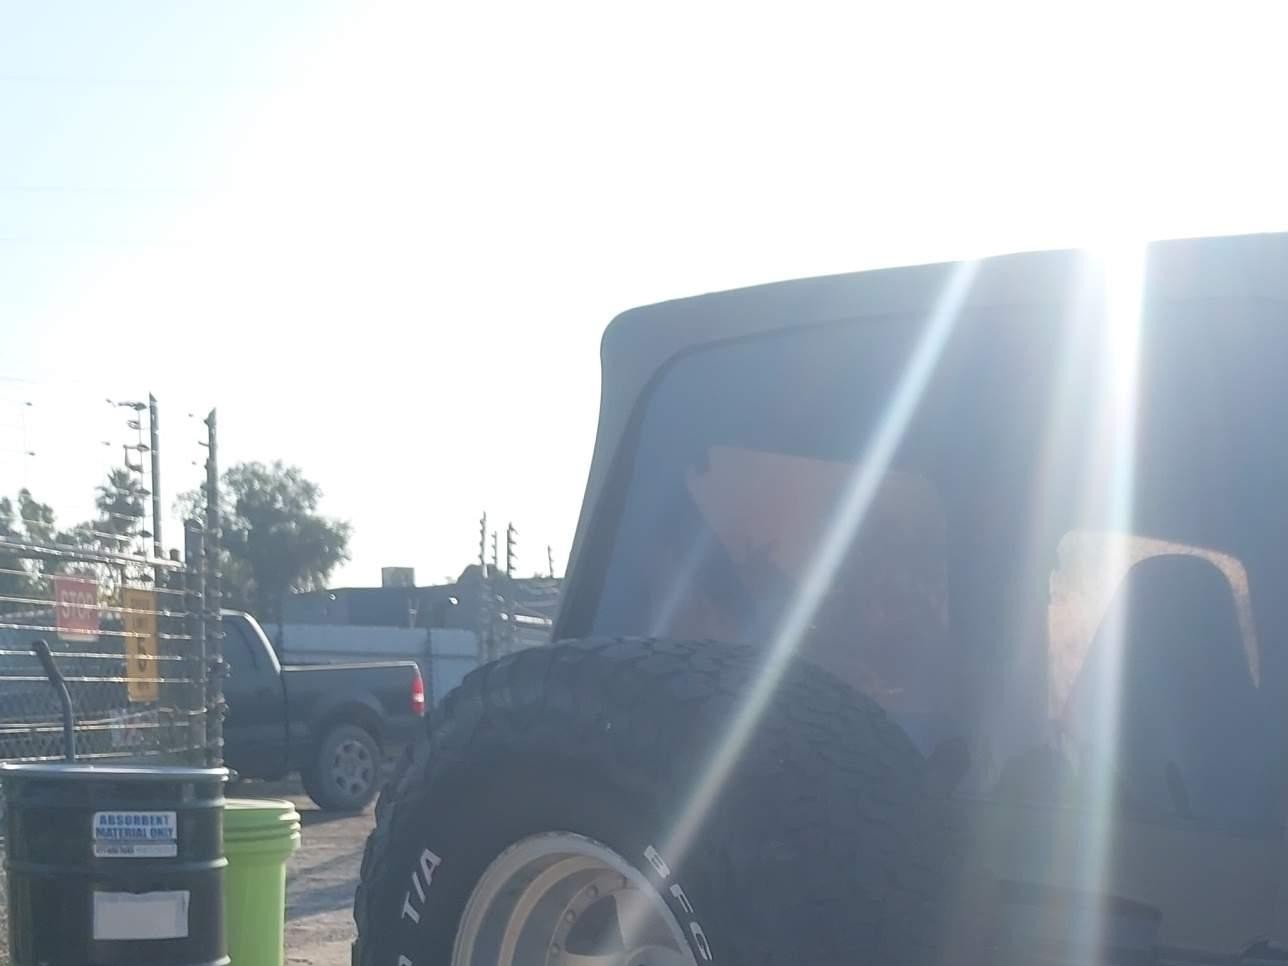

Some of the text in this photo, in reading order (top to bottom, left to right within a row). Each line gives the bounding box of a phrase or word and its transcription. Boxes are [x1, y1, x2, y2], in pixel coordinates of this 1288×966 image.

[61, 590, 95, 619] STOP
[100, 815, 169, 826] ABSORBENT
[96, 828, 174, 839] MATERIAL ONLY
[401, 847, 443, 924] T/A
